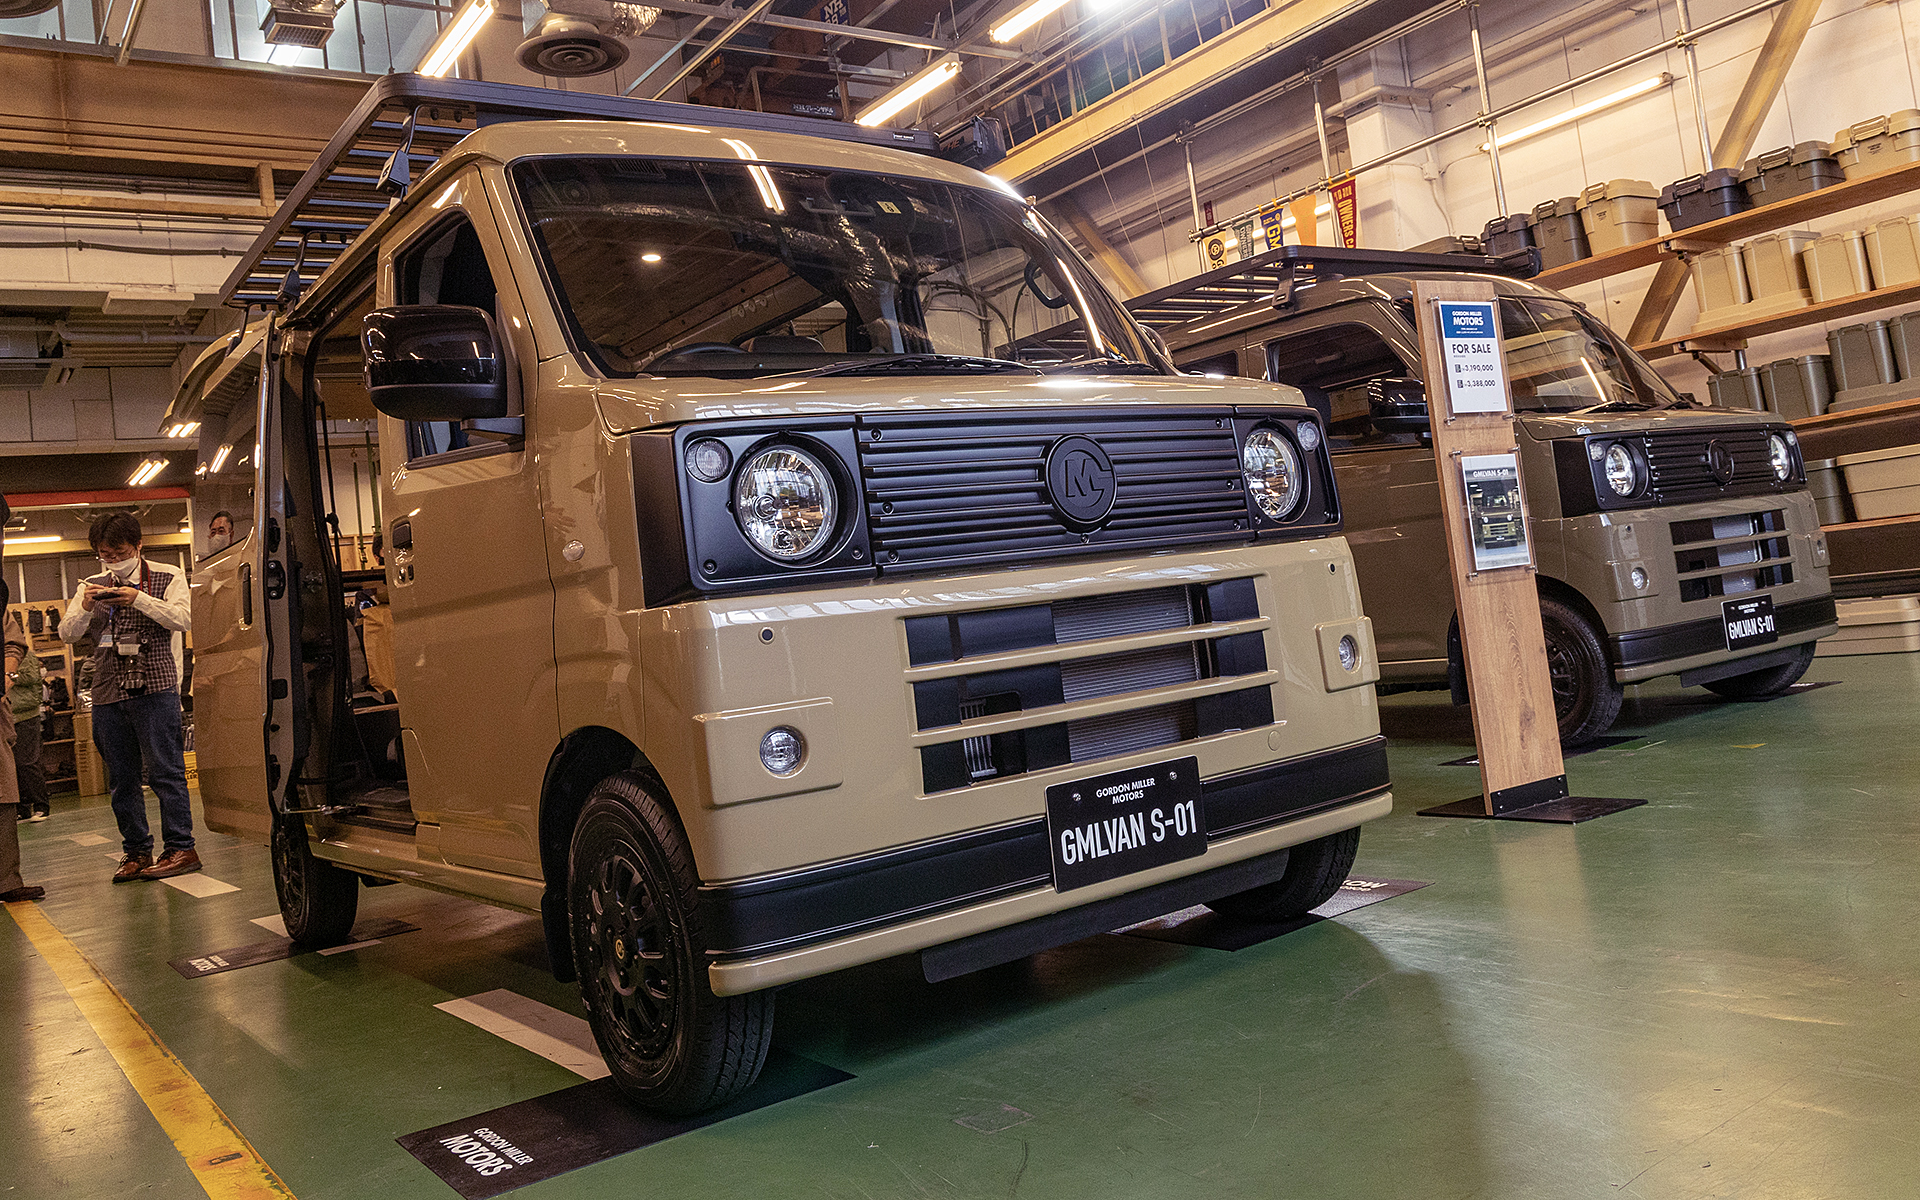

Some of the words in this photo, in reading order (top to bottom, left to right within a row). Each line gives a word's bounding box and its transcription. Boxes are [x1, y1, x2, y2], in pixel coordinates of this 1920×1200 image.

[1337, 198, 1355, 239] OWNERS
[1453, 316, 1484, 326] MOTORS
[1452, 344, 1470, 354] FOR
[1471, 344, 1491, 354] SALE
[1472, 470, 1496, 478] GMLVAN
[1497, 468, 1509, 476] S-01
[1728, 617, 1758, 640] GMLVAN
[1757, 614, 1775, 634] S-01
[1096, 783, 1130, 798] GORDON
[1131, 778, 1155, 792] MILLER
[1112, 790, 1144, 805] MOTORS
[1060, 812, 1147, 865] GMLVAN
[1150, 800, 1197, 843] S-01
[439, 1134, 514, 1176] MOTORS
[473, 1127, 513, 1150] GORDON
[500, 1146, 534, 1166] MILLER
